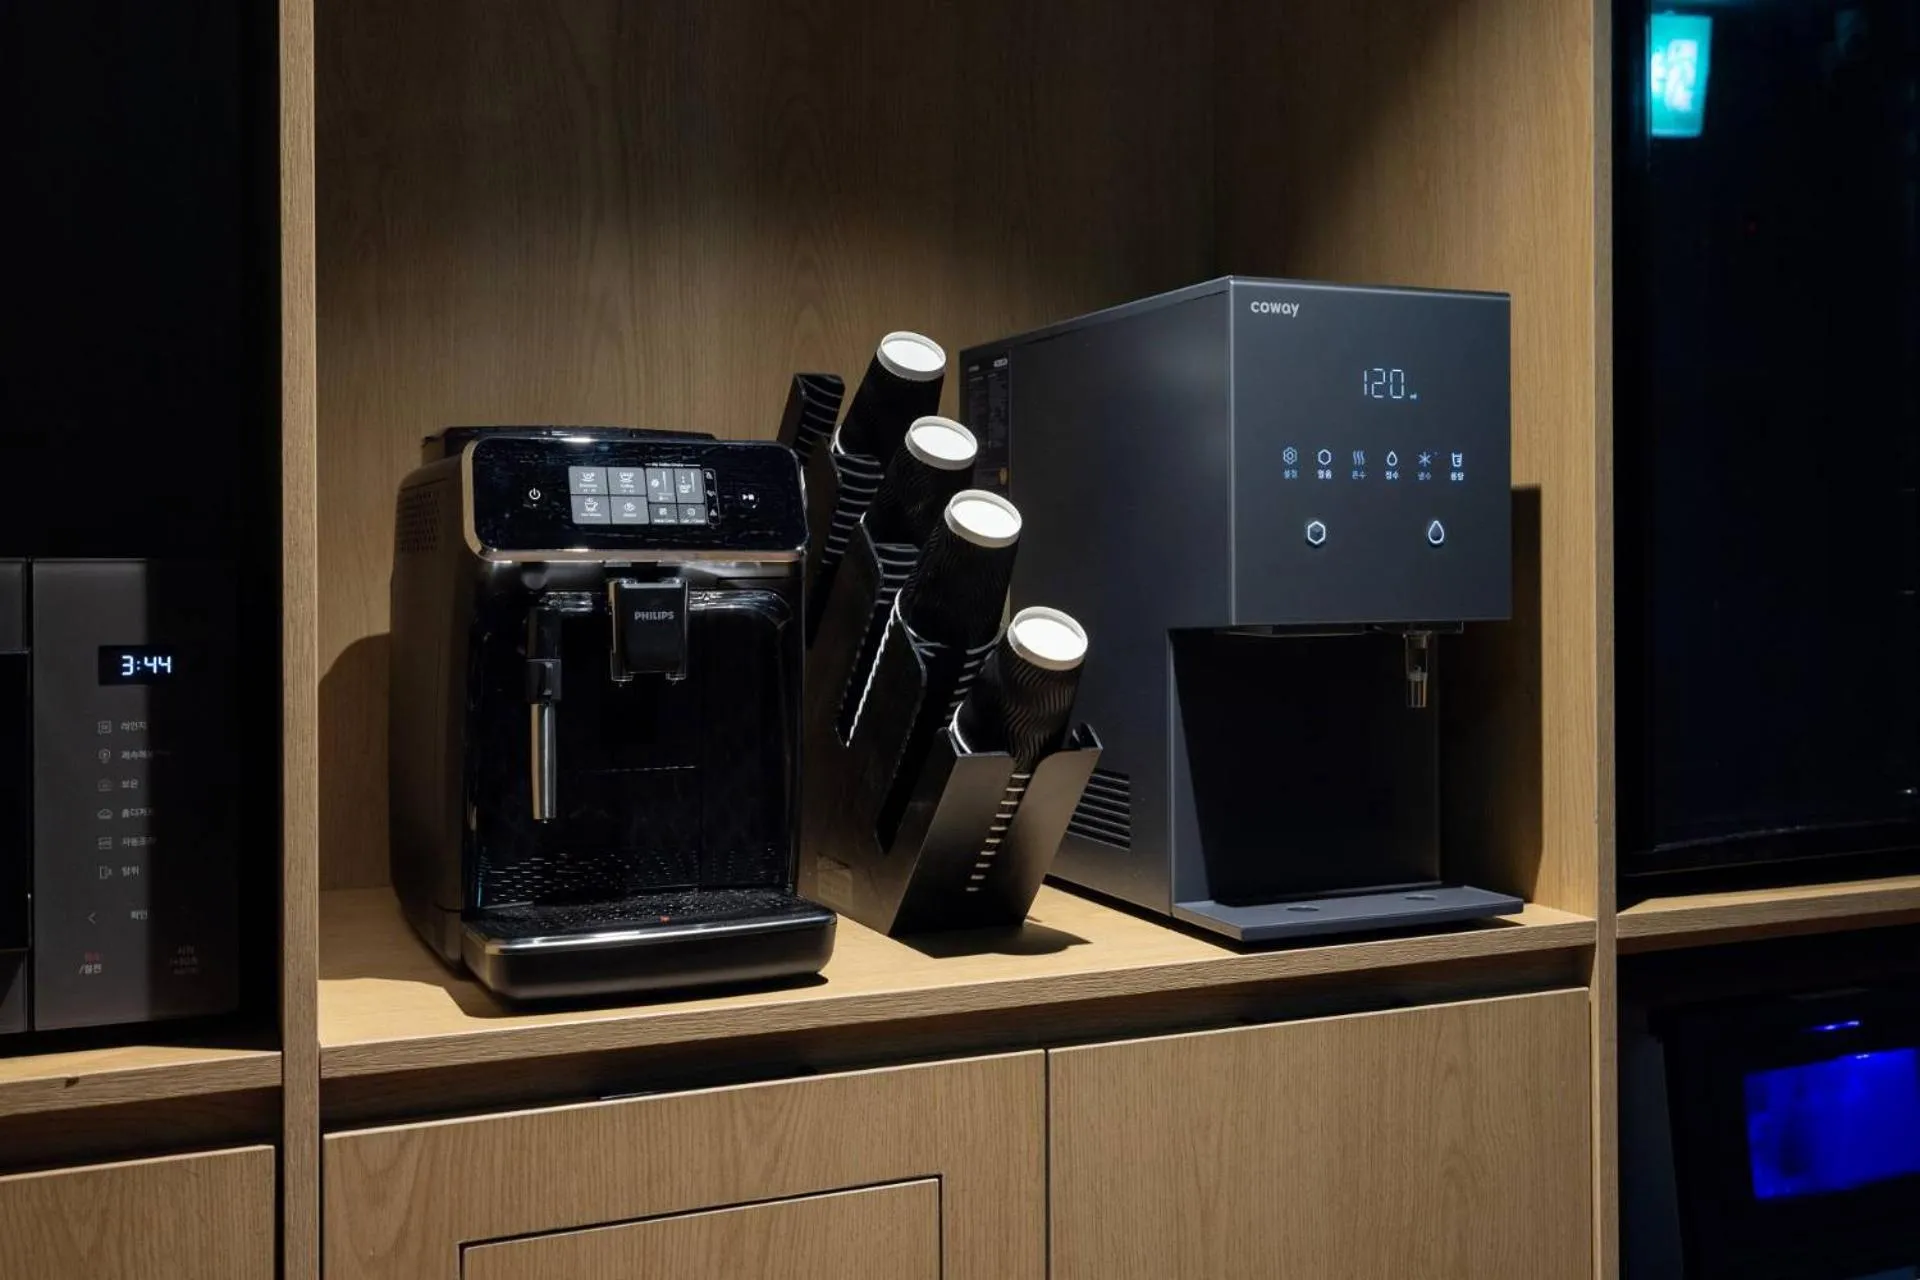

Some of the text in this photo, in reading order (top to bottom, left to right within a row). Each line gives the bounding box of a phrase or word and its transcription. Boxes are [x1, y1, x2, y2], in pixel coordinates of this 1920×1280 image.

[1250, 300, 1299, 318] coway
[1363, 367, 1405, 399] 120
[634, 611, 675, 621] PHILIPS
[120, 654, 172, 676] 3:44
